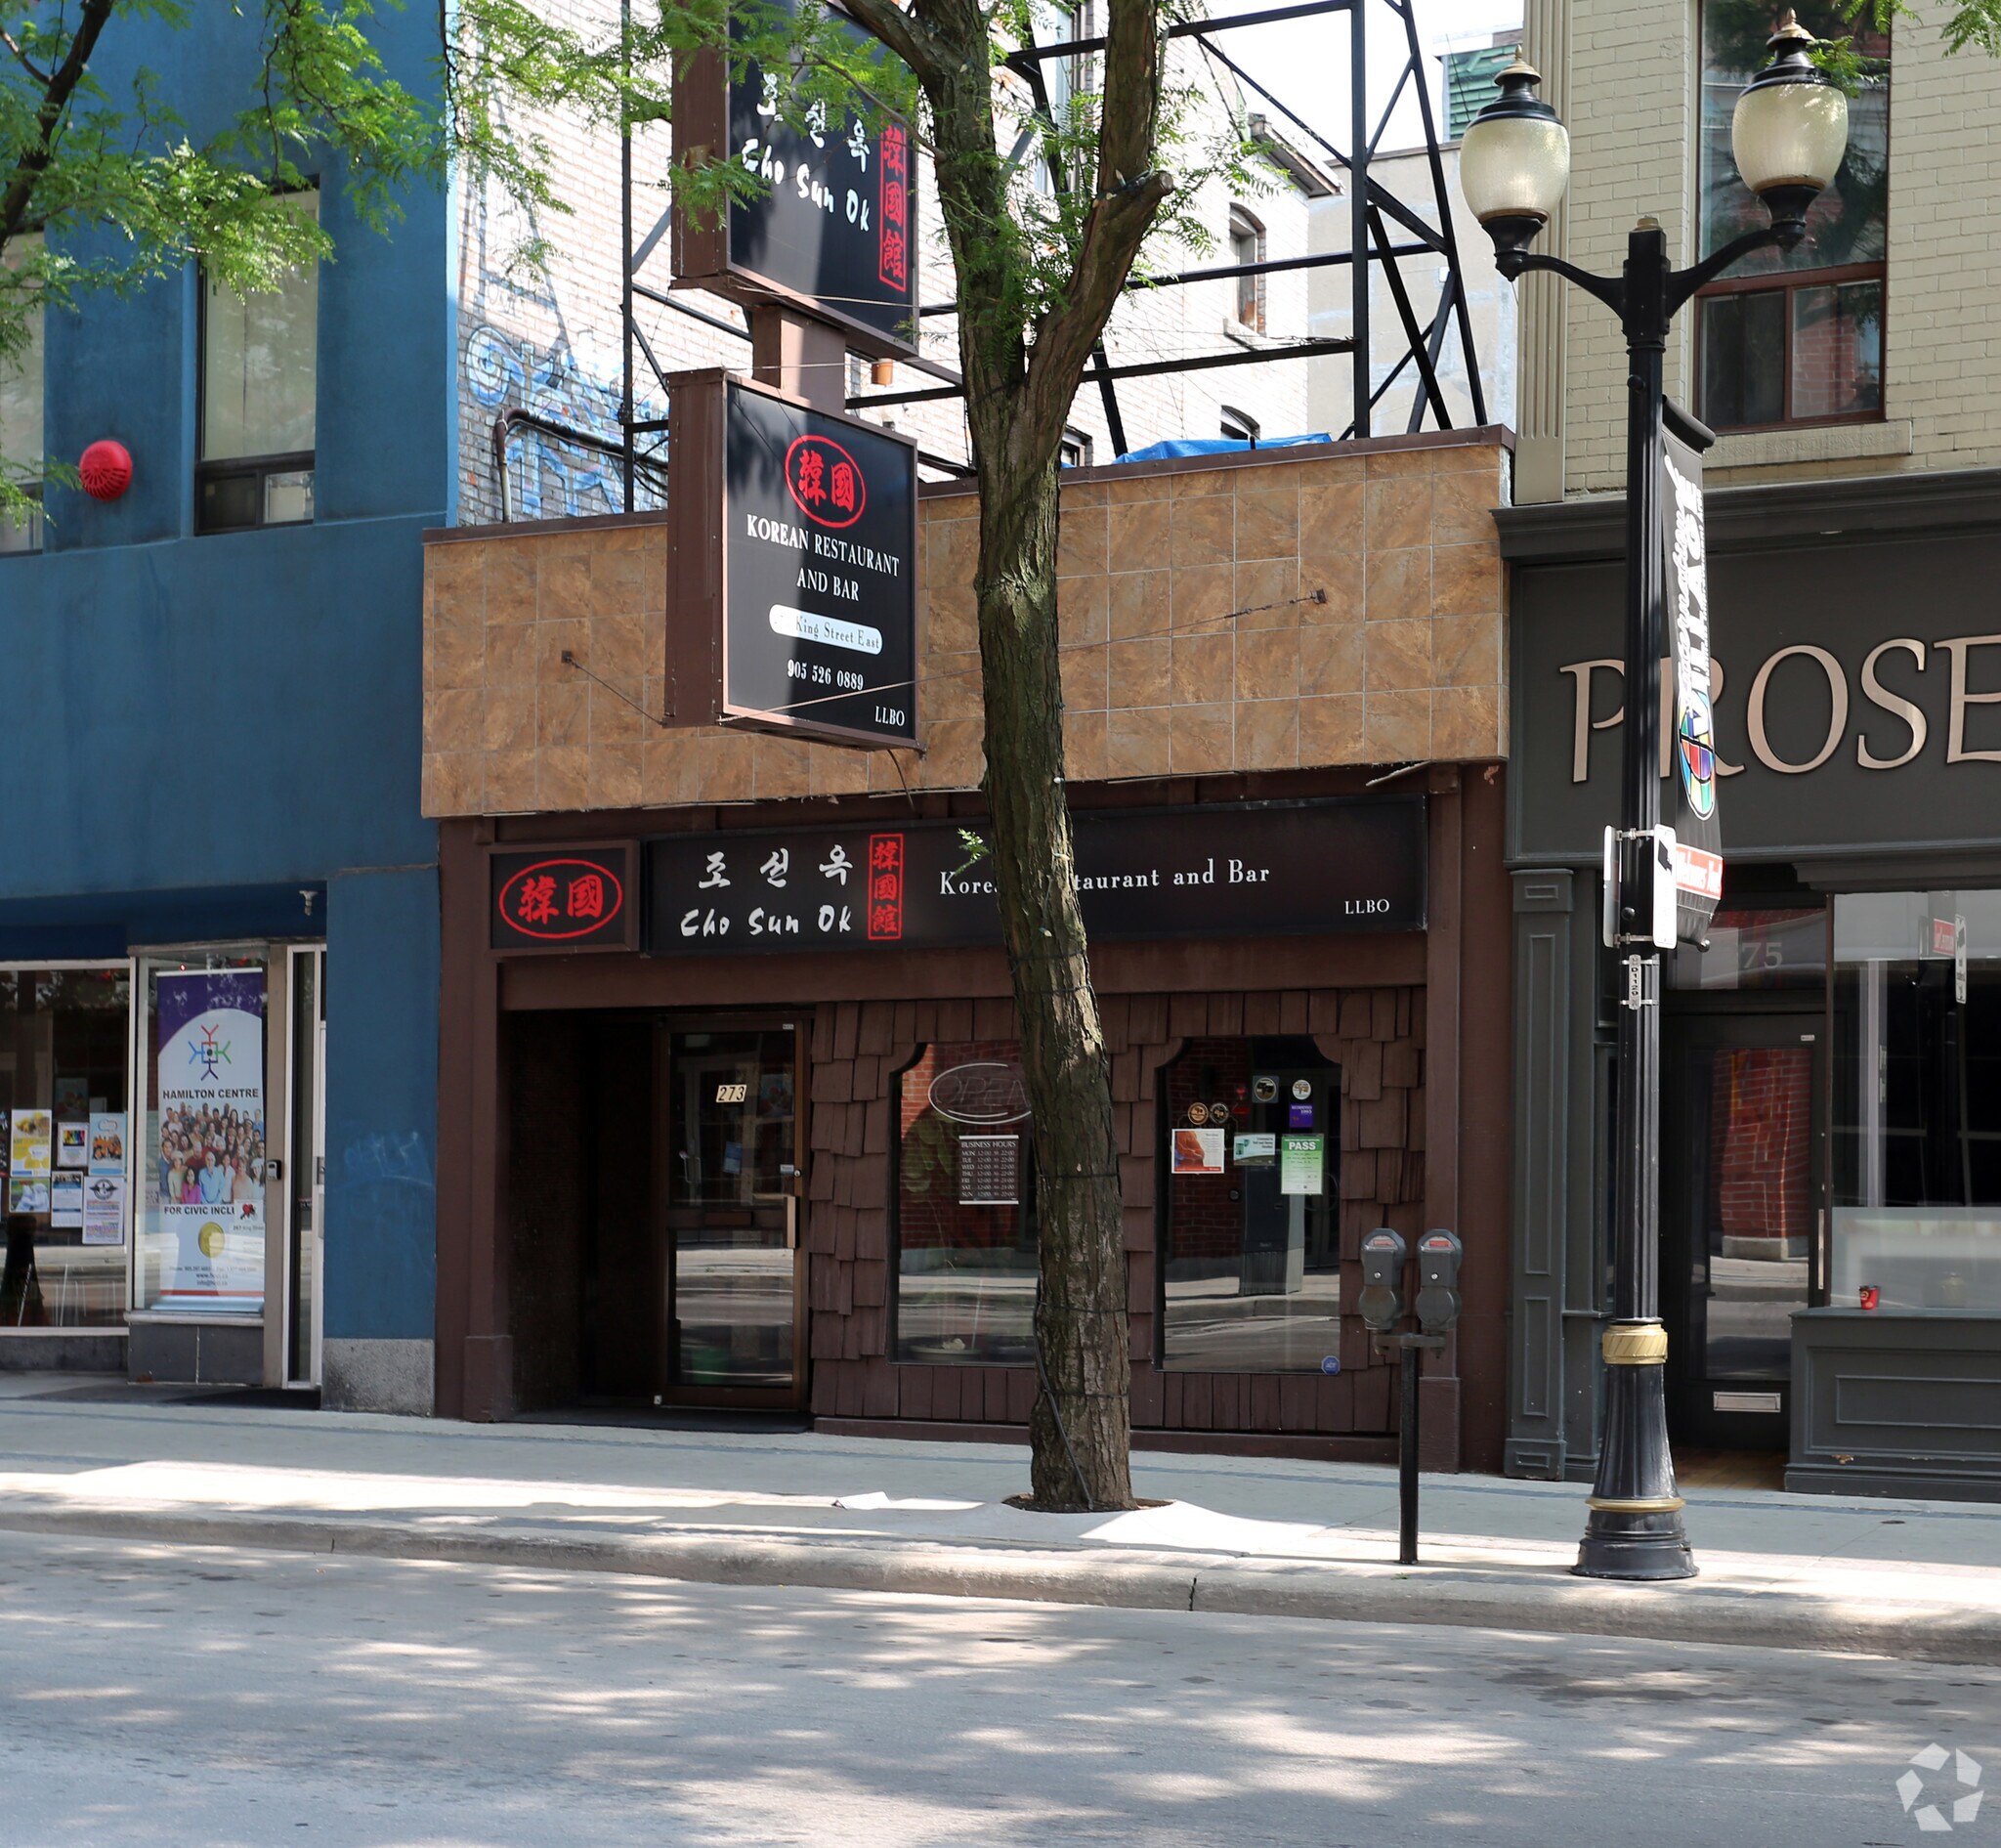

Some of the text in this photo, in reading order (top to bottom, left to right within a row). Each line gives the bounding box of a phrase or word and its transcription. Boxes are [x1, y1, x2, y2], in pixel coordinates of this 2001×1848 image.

[742, 138, 785, 185] Cho
[796, 163, 834, 213] Sun
[797, 448, 856, 514] 韓國
[746, 513, 900, 578] KOREAN RESTAURANT
[796, 567, 860, 602] AND BAR
[795, 615, 820, 640] King
[824, 622, 855, 644] Street
[857, 628, 880, 650] East
[787, 659, 865, 692] 905 526 0889
[874, 705, 907, 727] LLBO
[939, 871, 998, 895] Kore
[1172, 858, 1215, 886] and
[1227, 858, 1270, 884] Bar
[518, 874, 604, 925] 韓國
[1344, 897, 1390, 916] LLBO
[680, 908, 731, 937] Cho
[747, 906, 800, 936] Sun
[162, 1088, 259, 1099] HAMILTON CENTRE
[718, 1086, 745, 1101] 273
[1288, 1140, 1316, 1151] PASS
[164, 1206, 182, 1215] FOR
[184, 1205, 208, 1215] CIVIC
